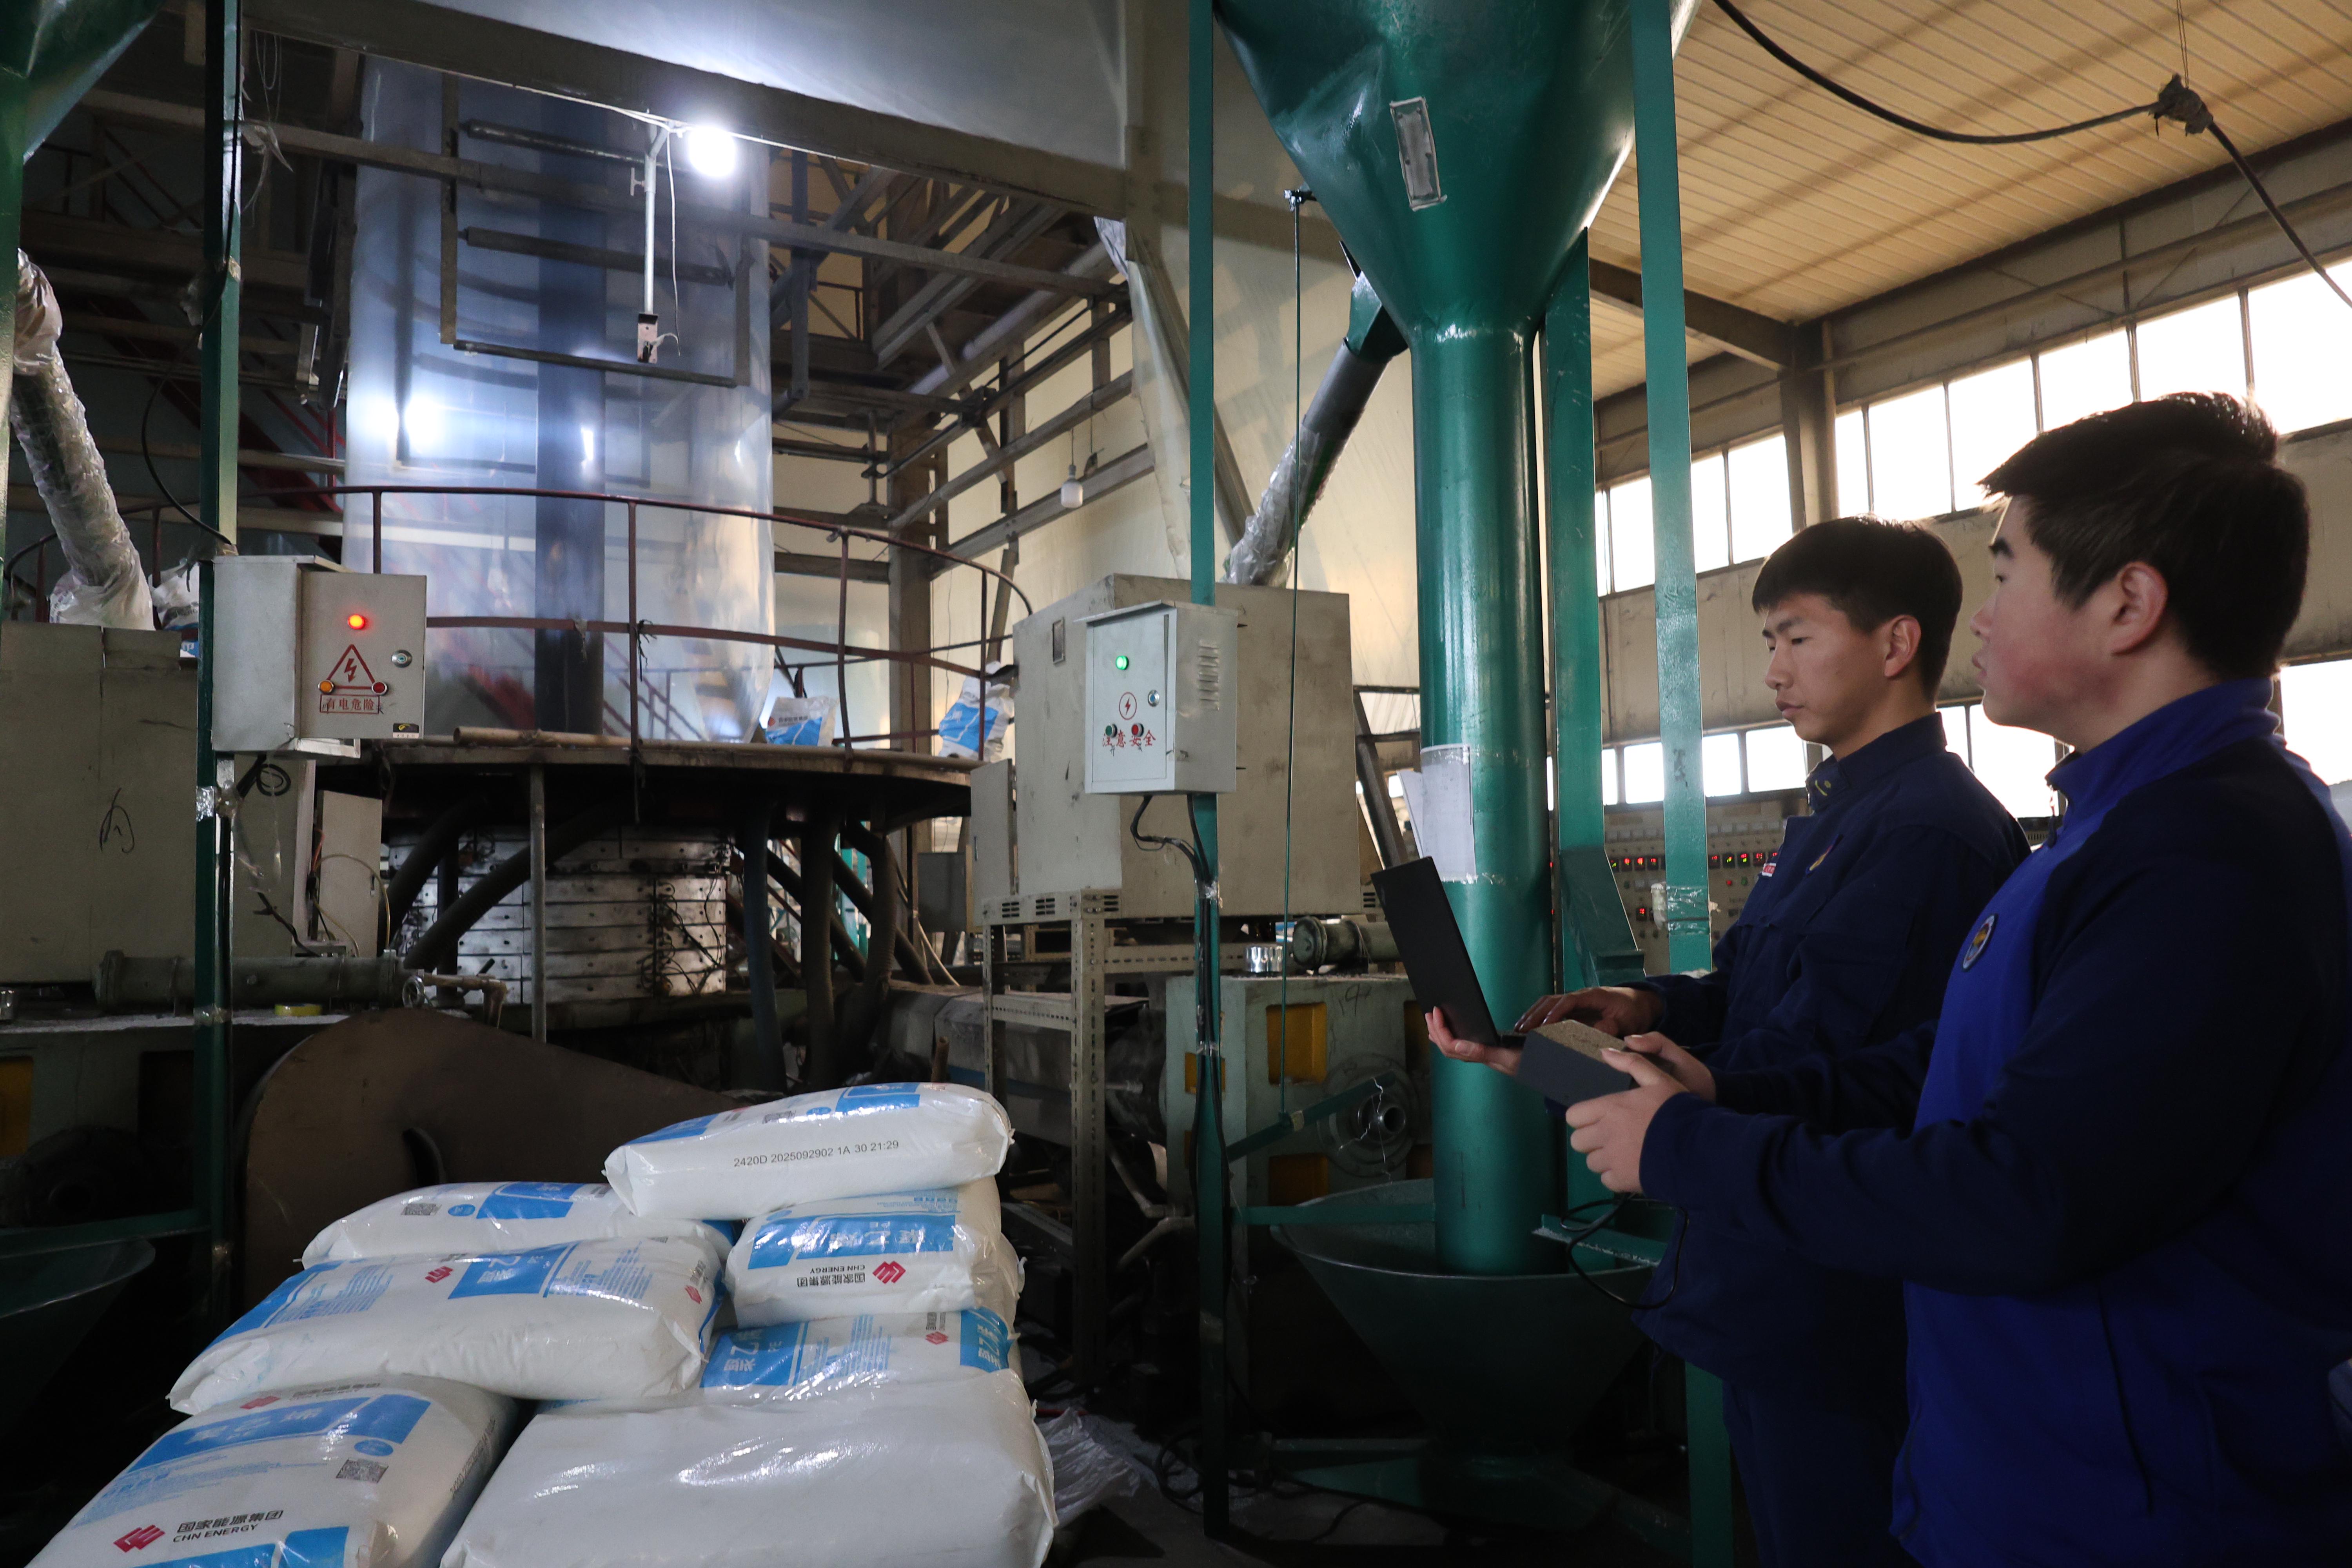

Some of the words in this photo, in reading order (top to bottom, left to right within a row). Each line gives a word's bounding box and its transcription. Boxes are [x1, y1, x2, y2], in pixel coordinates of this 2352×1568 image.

[326, 697, 375, 711] 有电危险
[734, 1155, 768, 1167] 2420D
[771, 1147, 834, 1163] 2025092902
[837, 1144, 851, 1156] 1A
[855, 1143, 867, 1153] 30
[870, 1140, 899, 1152] 21:29
[810, 1266, 845, 1274] ENERGY
[797, 1272, 866, 1287] 国家能源集团
[177, 1510, 284, 1533] 国家能源集团
[173, 1532, 201, 1543] CHN
[204, 1523, 259, 1538] ENERGY
